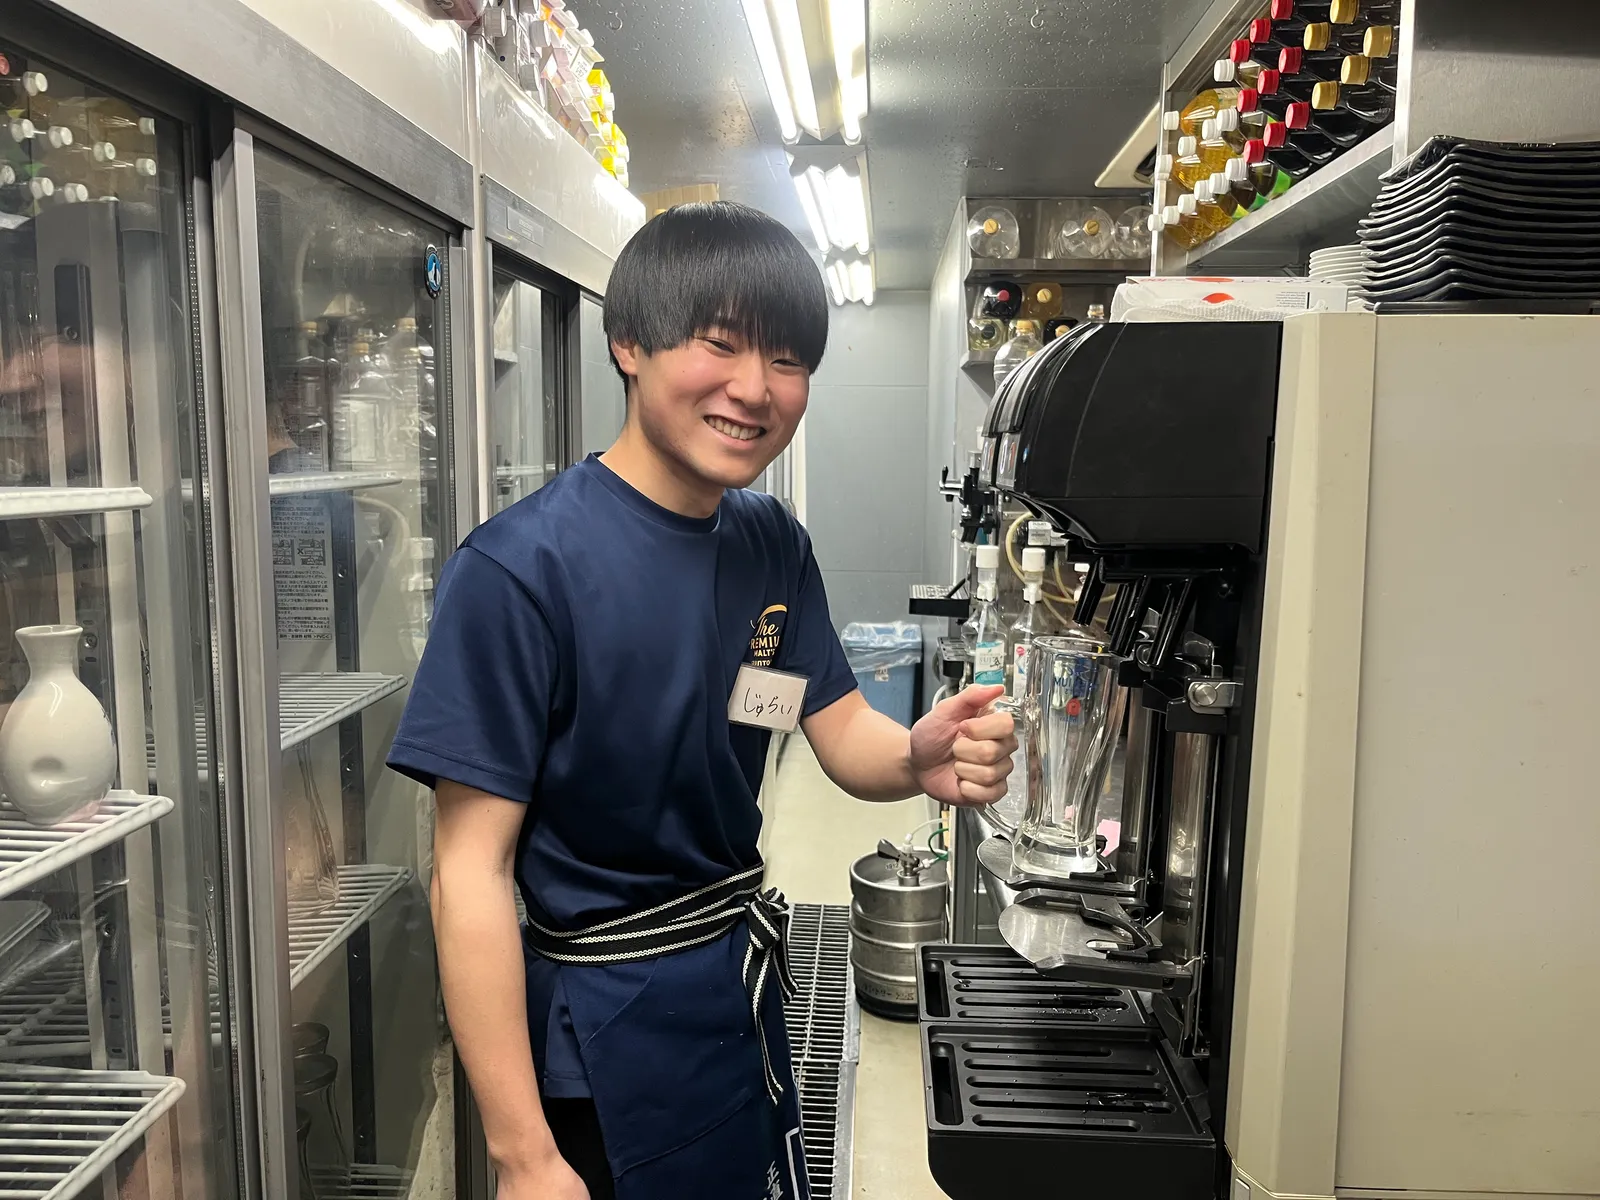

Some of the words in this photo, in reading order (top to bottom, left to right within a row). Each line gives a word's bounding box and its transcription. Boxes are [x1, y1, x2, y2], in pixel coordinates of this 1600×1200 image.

[749, 636, 780, 650] REMIU
[743, 687, 793, 718] じゅらい
